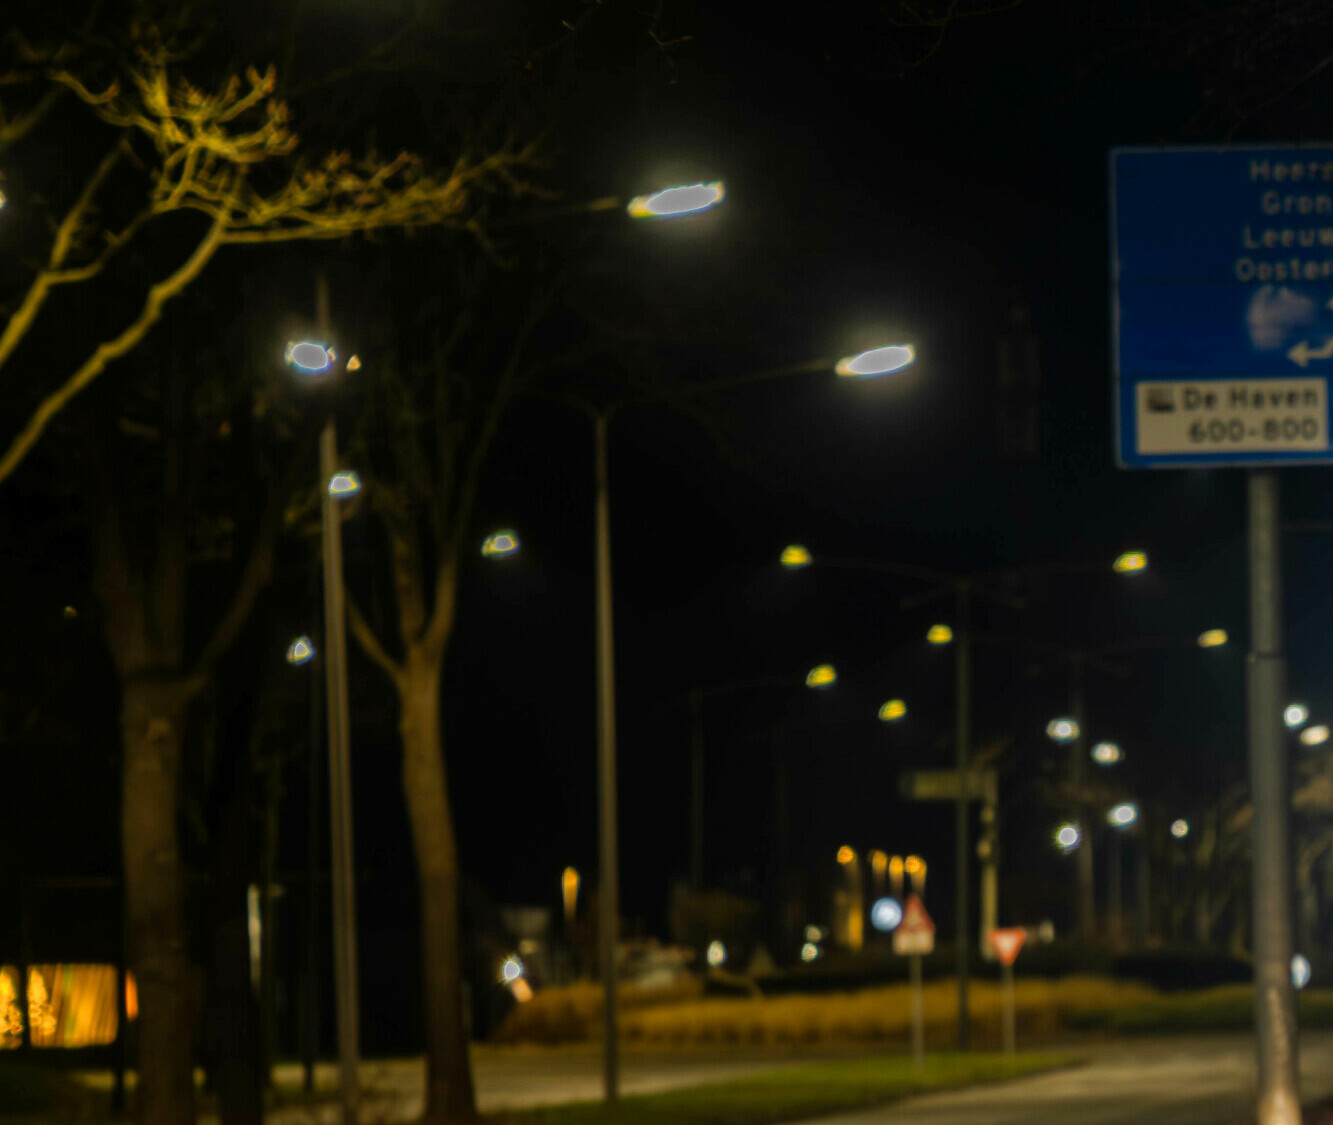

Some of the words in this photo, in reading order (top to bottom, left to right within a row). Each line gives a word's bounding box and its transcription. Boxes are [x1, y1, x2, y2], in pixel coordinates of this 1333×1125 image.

[1183, 386, 1218, 411] De
[1229, 384, 1319, 409] Haven
[1189, 416, 1320, 444] 600-800
